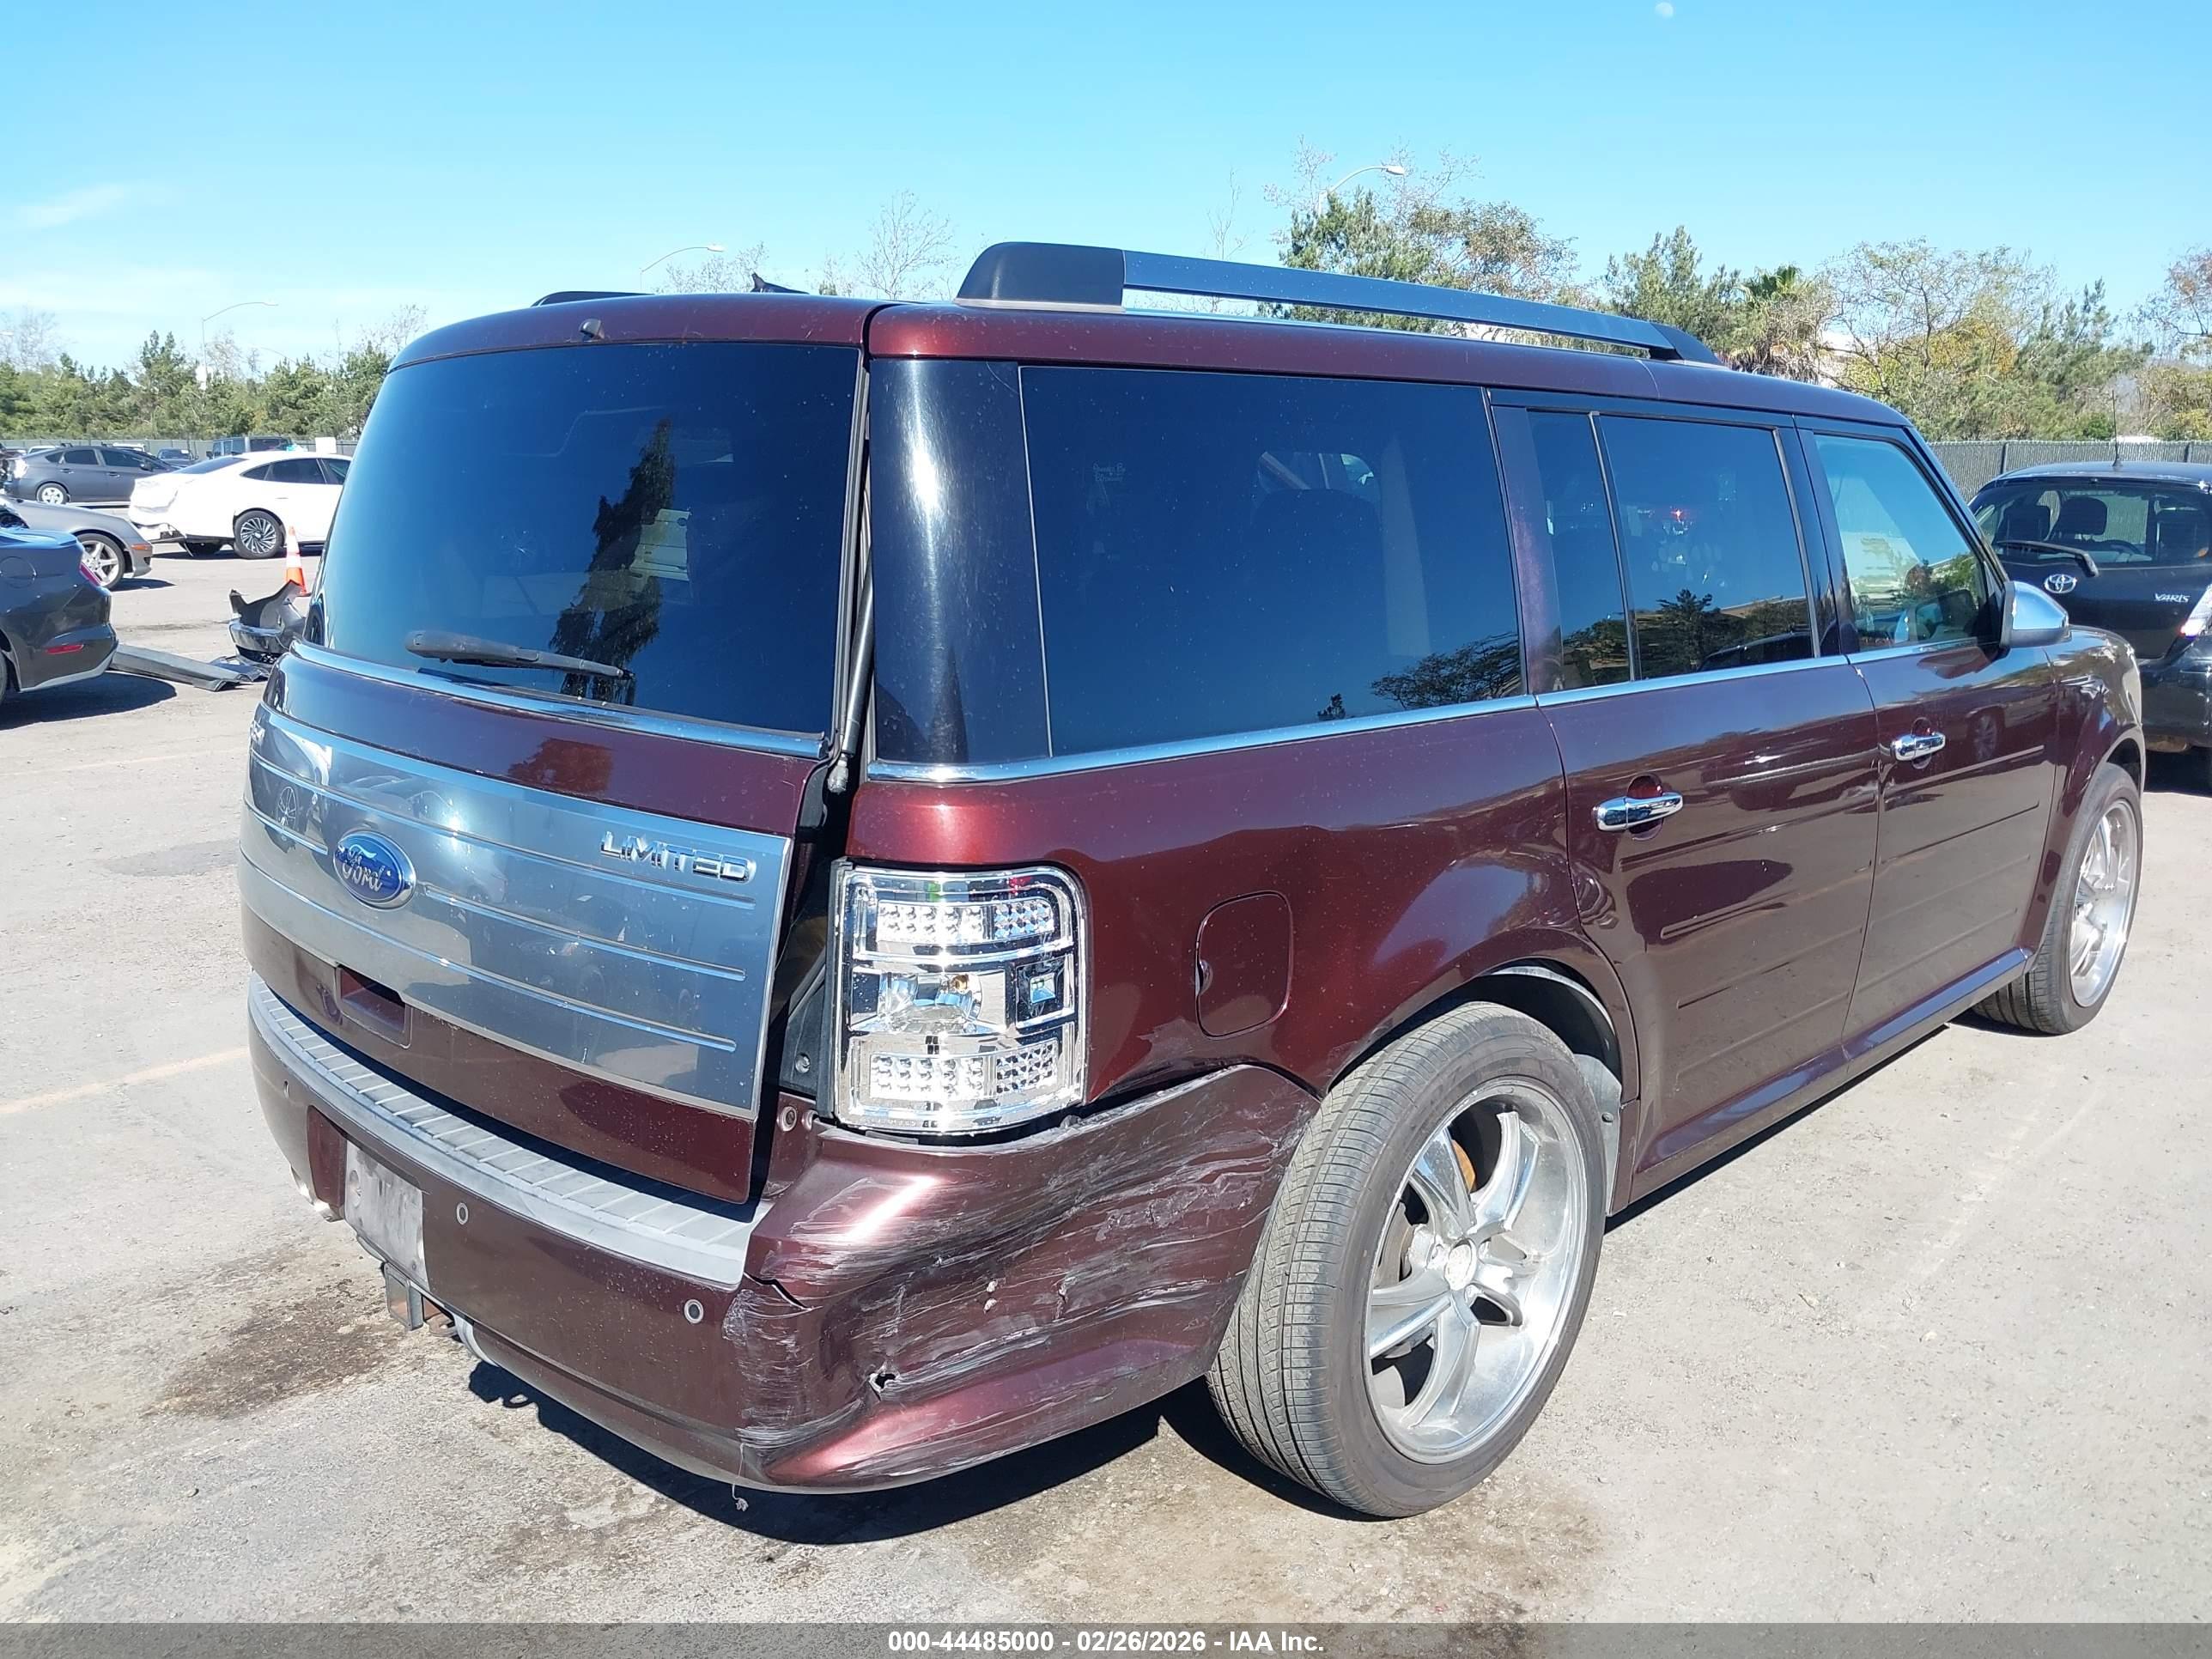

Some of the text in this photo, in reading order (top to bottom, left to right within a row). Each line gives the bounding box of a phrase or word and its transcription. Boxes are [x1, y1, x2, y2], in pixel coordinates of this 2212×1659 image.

[2154, 592, 2191, 603] YARIS
[342, 843, 387, 892] Ford
[600, 830, 757, 884] LIMITED
